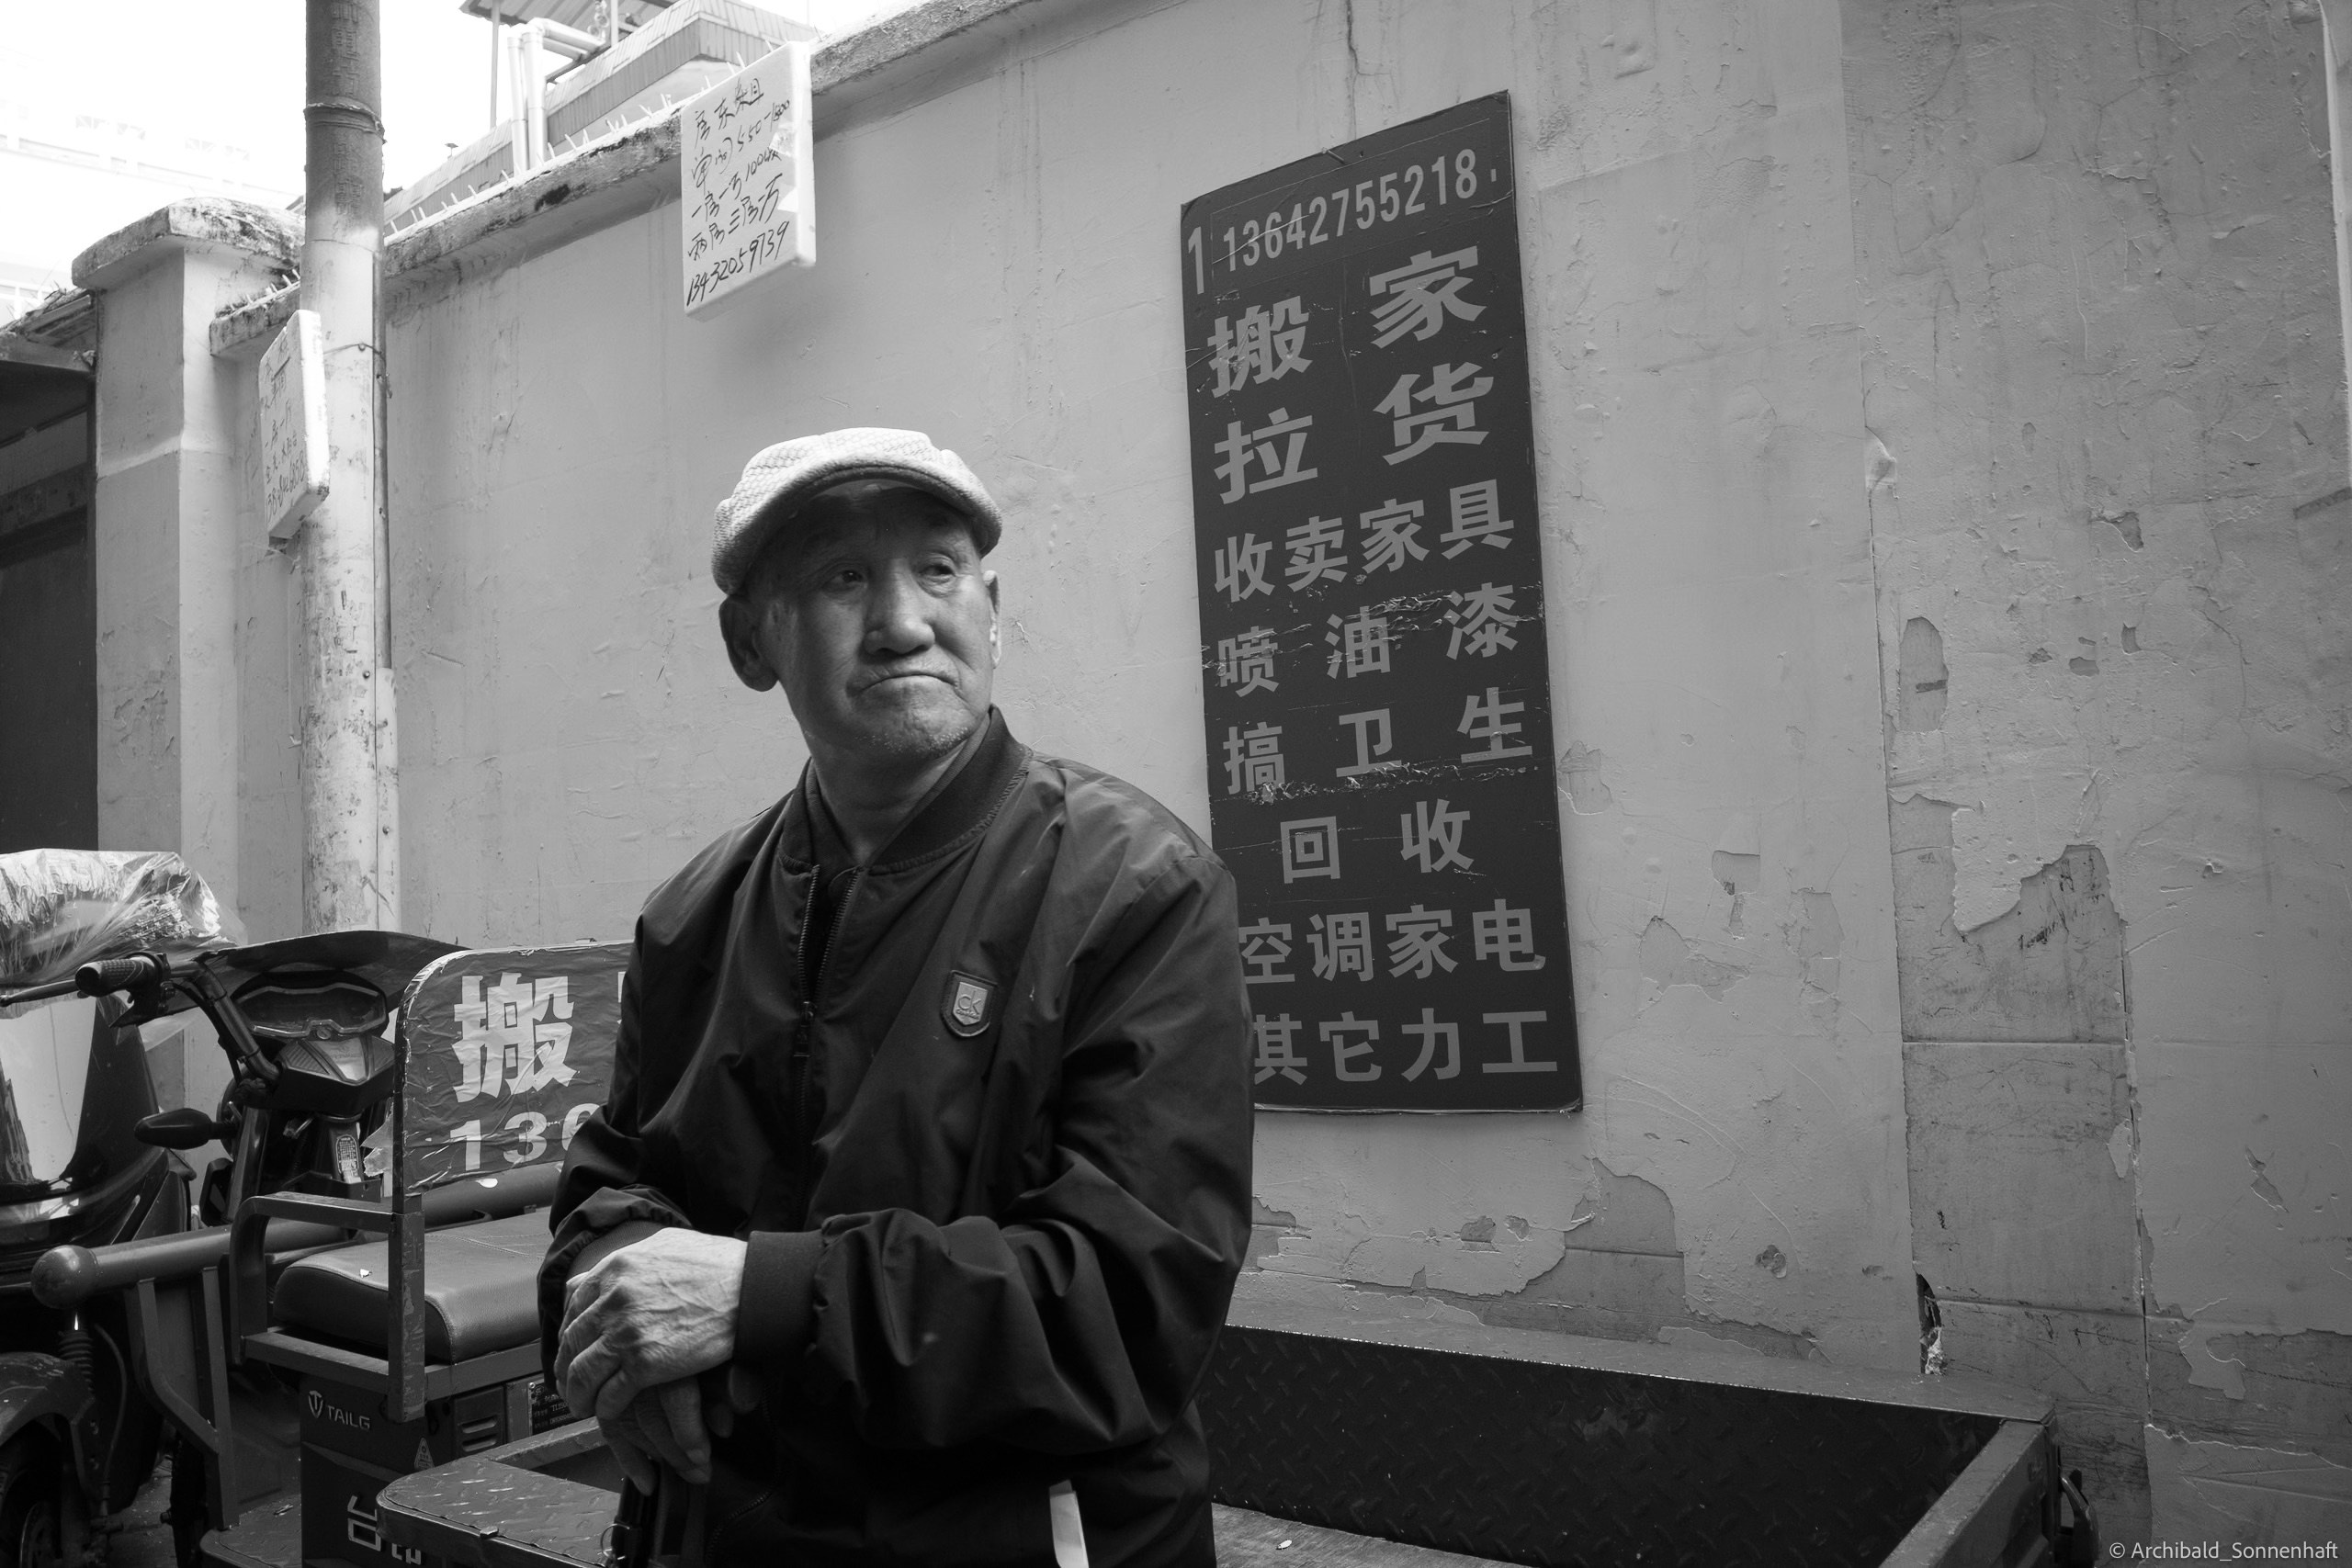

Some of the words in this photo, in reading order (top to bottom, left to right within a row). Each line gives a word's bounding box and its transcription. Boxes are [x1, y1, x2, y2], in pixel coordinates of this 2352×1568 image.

[1223, 149, 1477, 272] 13642755218
[686, 220, 790, 307] 13432059739
[1215, 479, 1514, 603] 收卖家具
[1217, 581, 1519, 697] 喷油漆
[1223, 687, 1532, 795] 搞卫生
[1280, 798, 1474, 884] 回收
[1238, 898, 1546, 984] 空调家电
[451, 971, 627, 1102] 搬
[1253, 1008, 1557, 1085] 其它力工
[326, 1404, 370, 1430] TAILG
